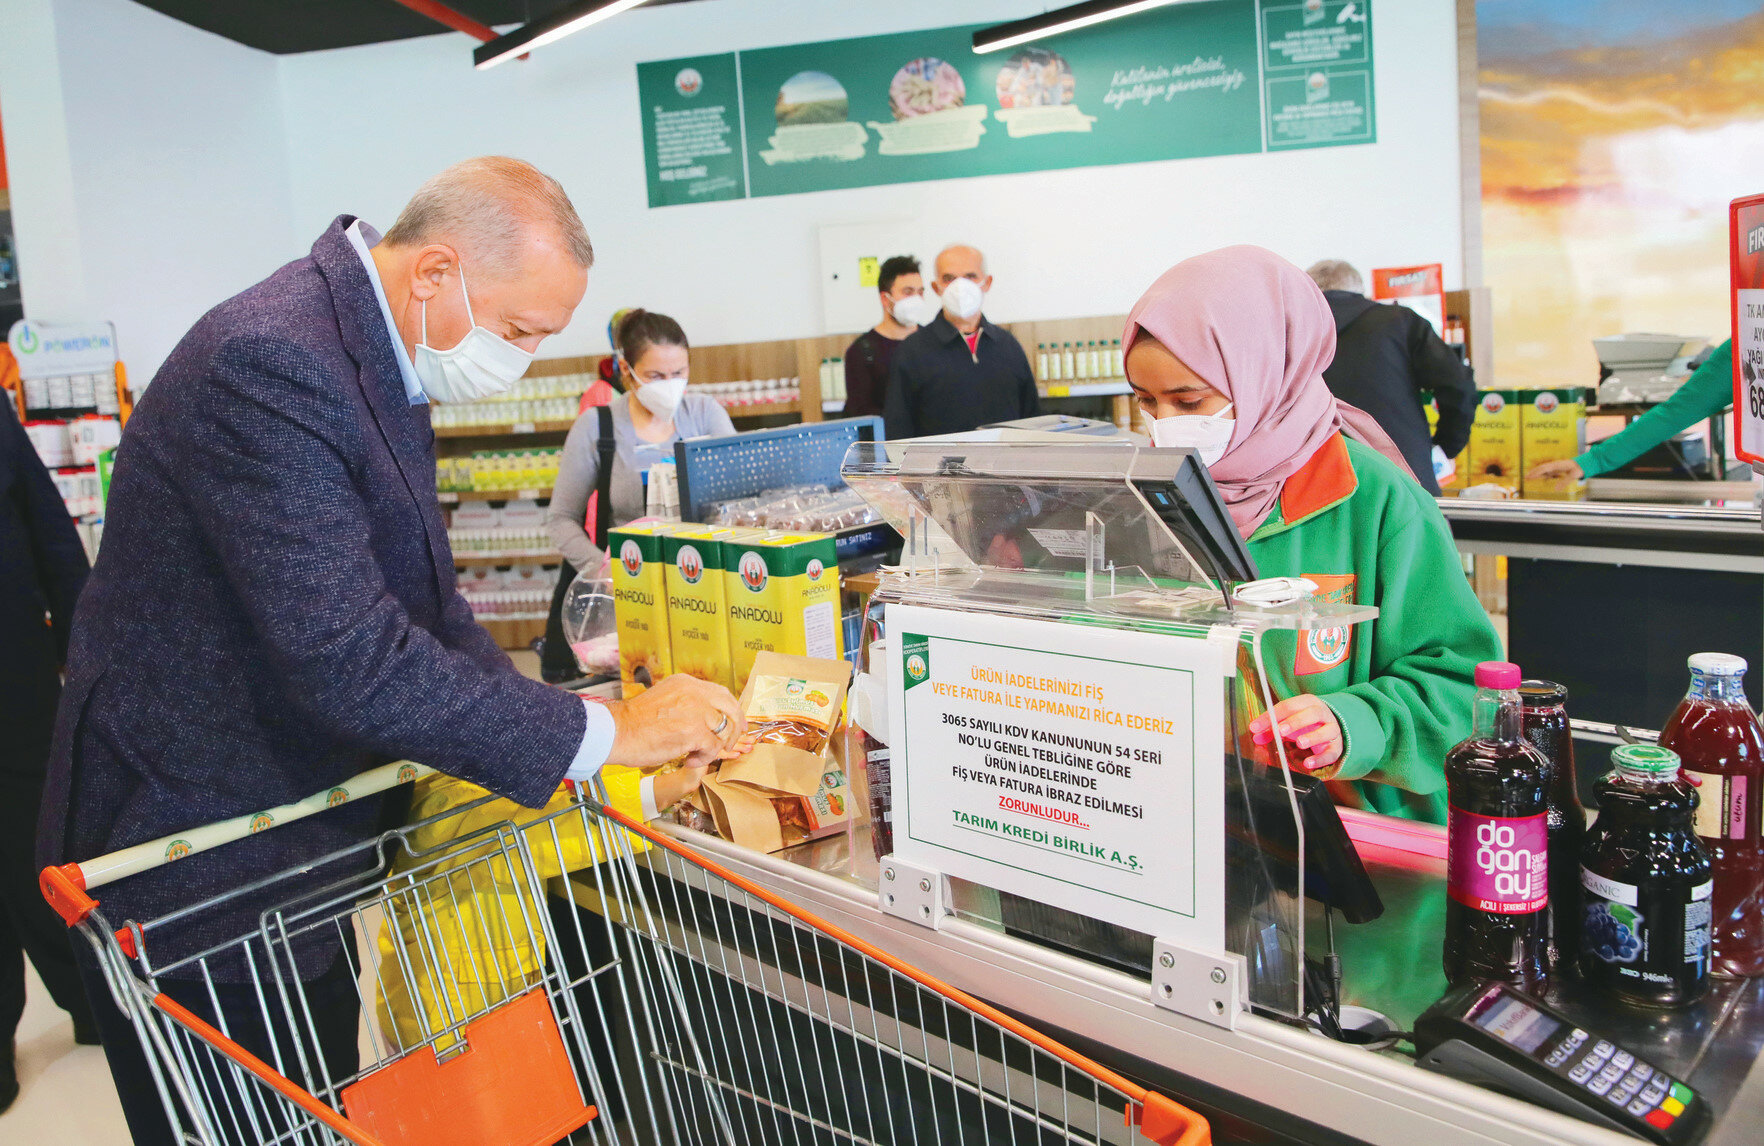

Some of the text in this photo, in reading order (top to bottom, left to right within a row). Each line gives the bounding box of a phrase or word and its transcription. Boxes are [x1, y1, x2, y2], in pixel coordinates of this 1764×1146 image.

[1747, 304, 1755, 318] TK
[1747, 348, 1763, 367] YAĞI
[615, 589, 654, 606] ANADOLU
[669, 596, 717, 615] ANADOLU
[730, 606, 783, 625] ANADOLU
[971, 664, 1104, 704] ÜRÜN İADELERİNİZİ FİŞ
[932, 682, 1174, 735] VEYE FATURA İLE YAPMANIZI RİCA EDERİZ
[942, 712, 1162, 765] 3065 SAYILI KDV KANUNUNUN 54 SERİ
[984, 754, 1097, 790] ÜRÜN İADELERİNDE
[994, 741, 1030, 758] GENEL
[1032, 748, 1093, 771] TEBLİĞİNE
[1096, 761, 1132, 779] GÖRE
[952, 765, 1143, 819] FİŞ VEYA FATURA İBRAZ EDİLMESİ
[998, 796, 1090, 828] ZORUNLUDUR...
[952, 810, 1144, 871] TARIM KREDİ BİRLİK A.Ş.
[1476, 819, 1515, 848] do
[1494, 872, 1532, 900] ay
